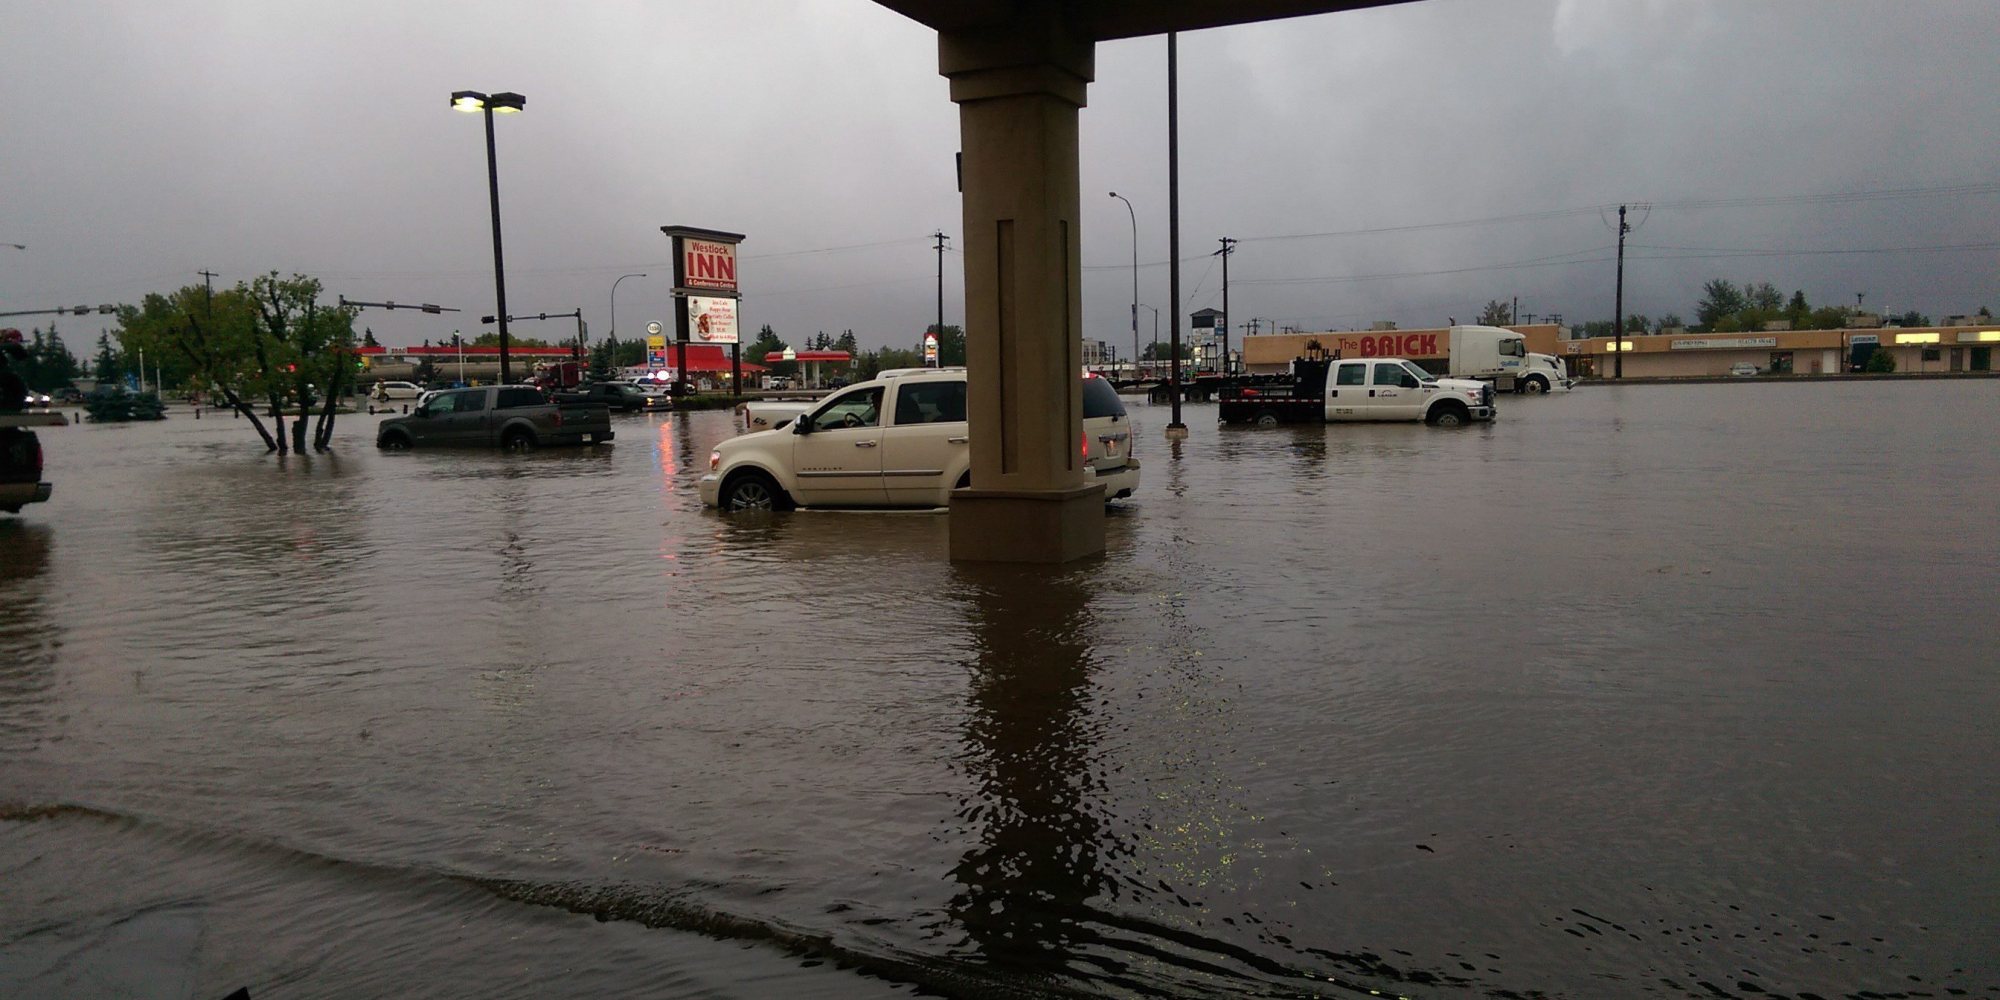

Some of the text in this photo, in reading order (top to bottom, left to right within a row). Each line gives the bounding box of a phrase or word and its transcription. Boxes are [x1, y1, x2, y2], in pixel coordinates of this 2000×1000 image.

[692, 241, 728, 255] Westlock
[688, 252, 734, 280] INN
[693, 279, 719, 288] Conference
[1338, 334, 1437, 357] The BRICK
